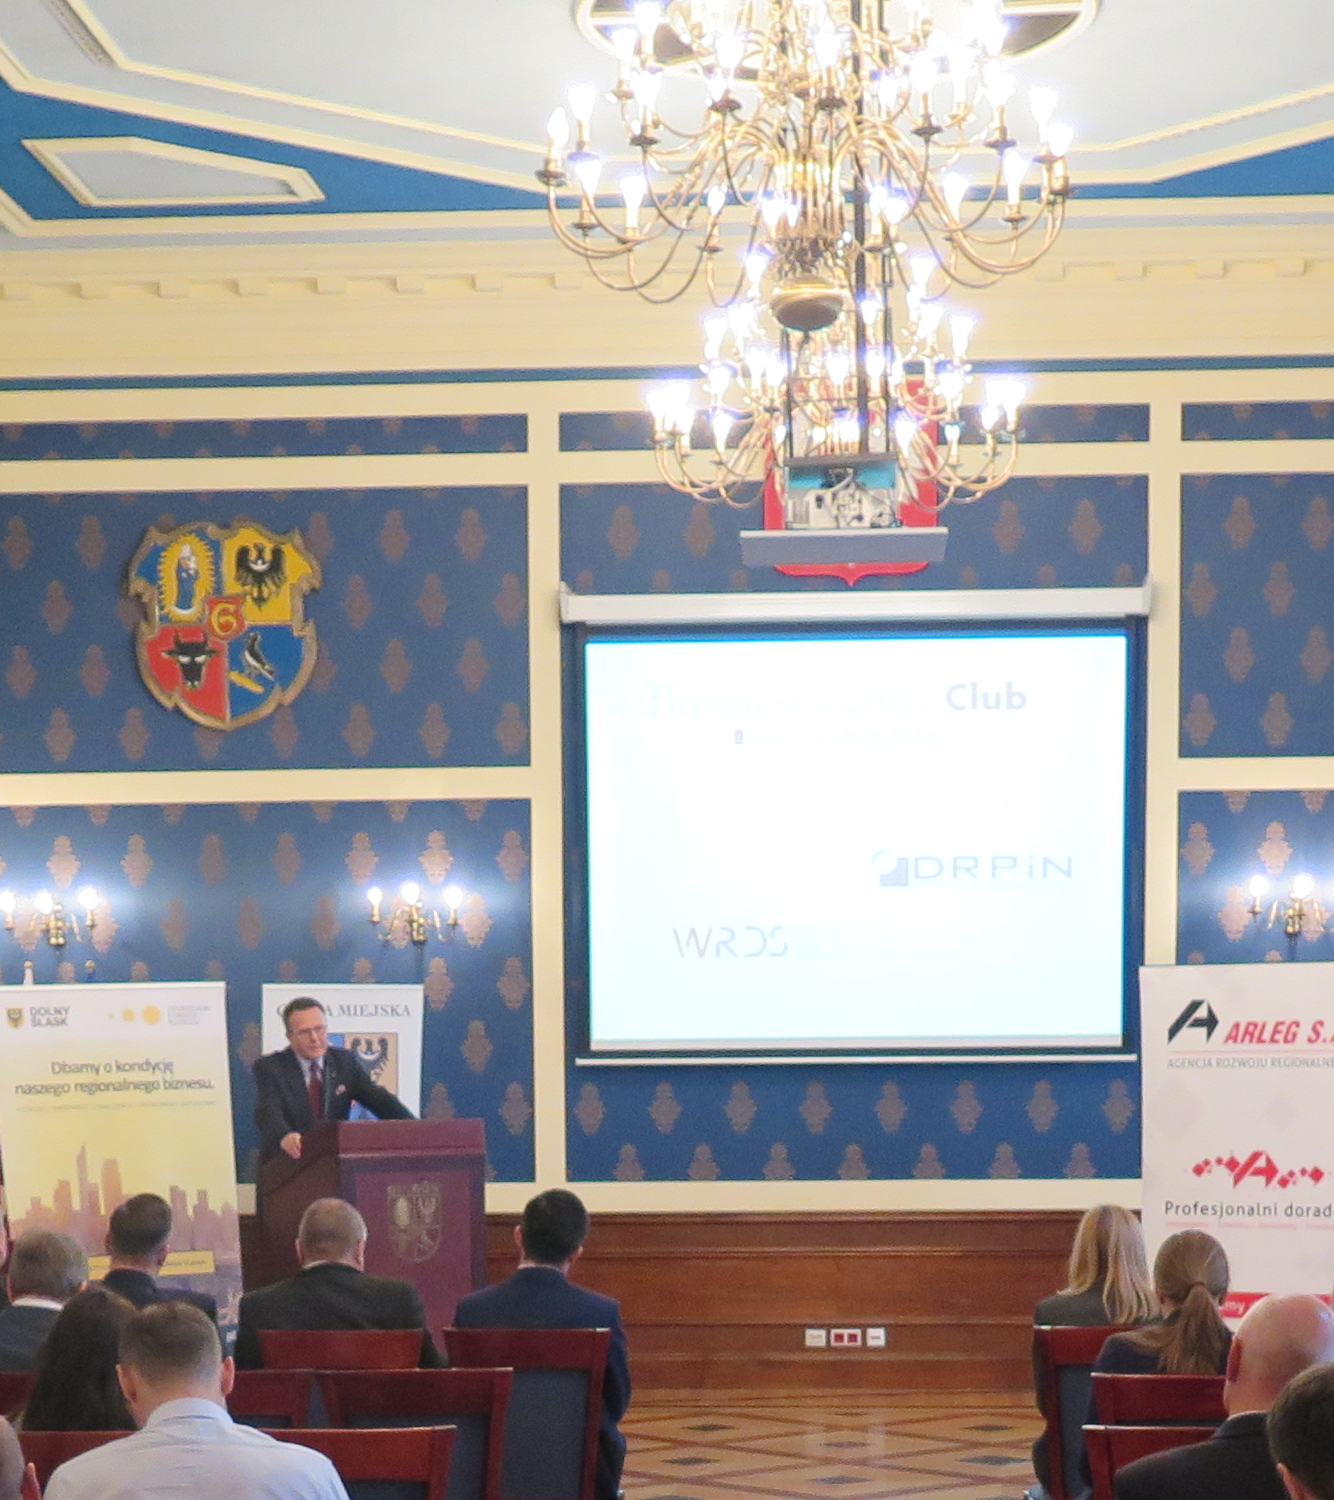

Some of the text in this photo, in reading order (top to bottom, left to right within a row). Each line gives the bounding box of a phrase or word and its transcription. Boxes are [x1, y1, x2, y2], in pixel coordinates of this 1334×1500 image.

[946, 681, 1027, 712] Club
[672, 926, 789, 959] WRDS
[29, 1005, 70, 1016] DOLNY
[337, 1003, 411, 1017] MIEJSKA
[1223, 1020, 1301, 1044] ARLEG
[50, 1058, 174, 1076] Dbamy o kondycję
[15, 1077, 215, 1097] naszego regionalnego biznesu.
[1164, 1201, 1278, 1219] Profesjonalni
